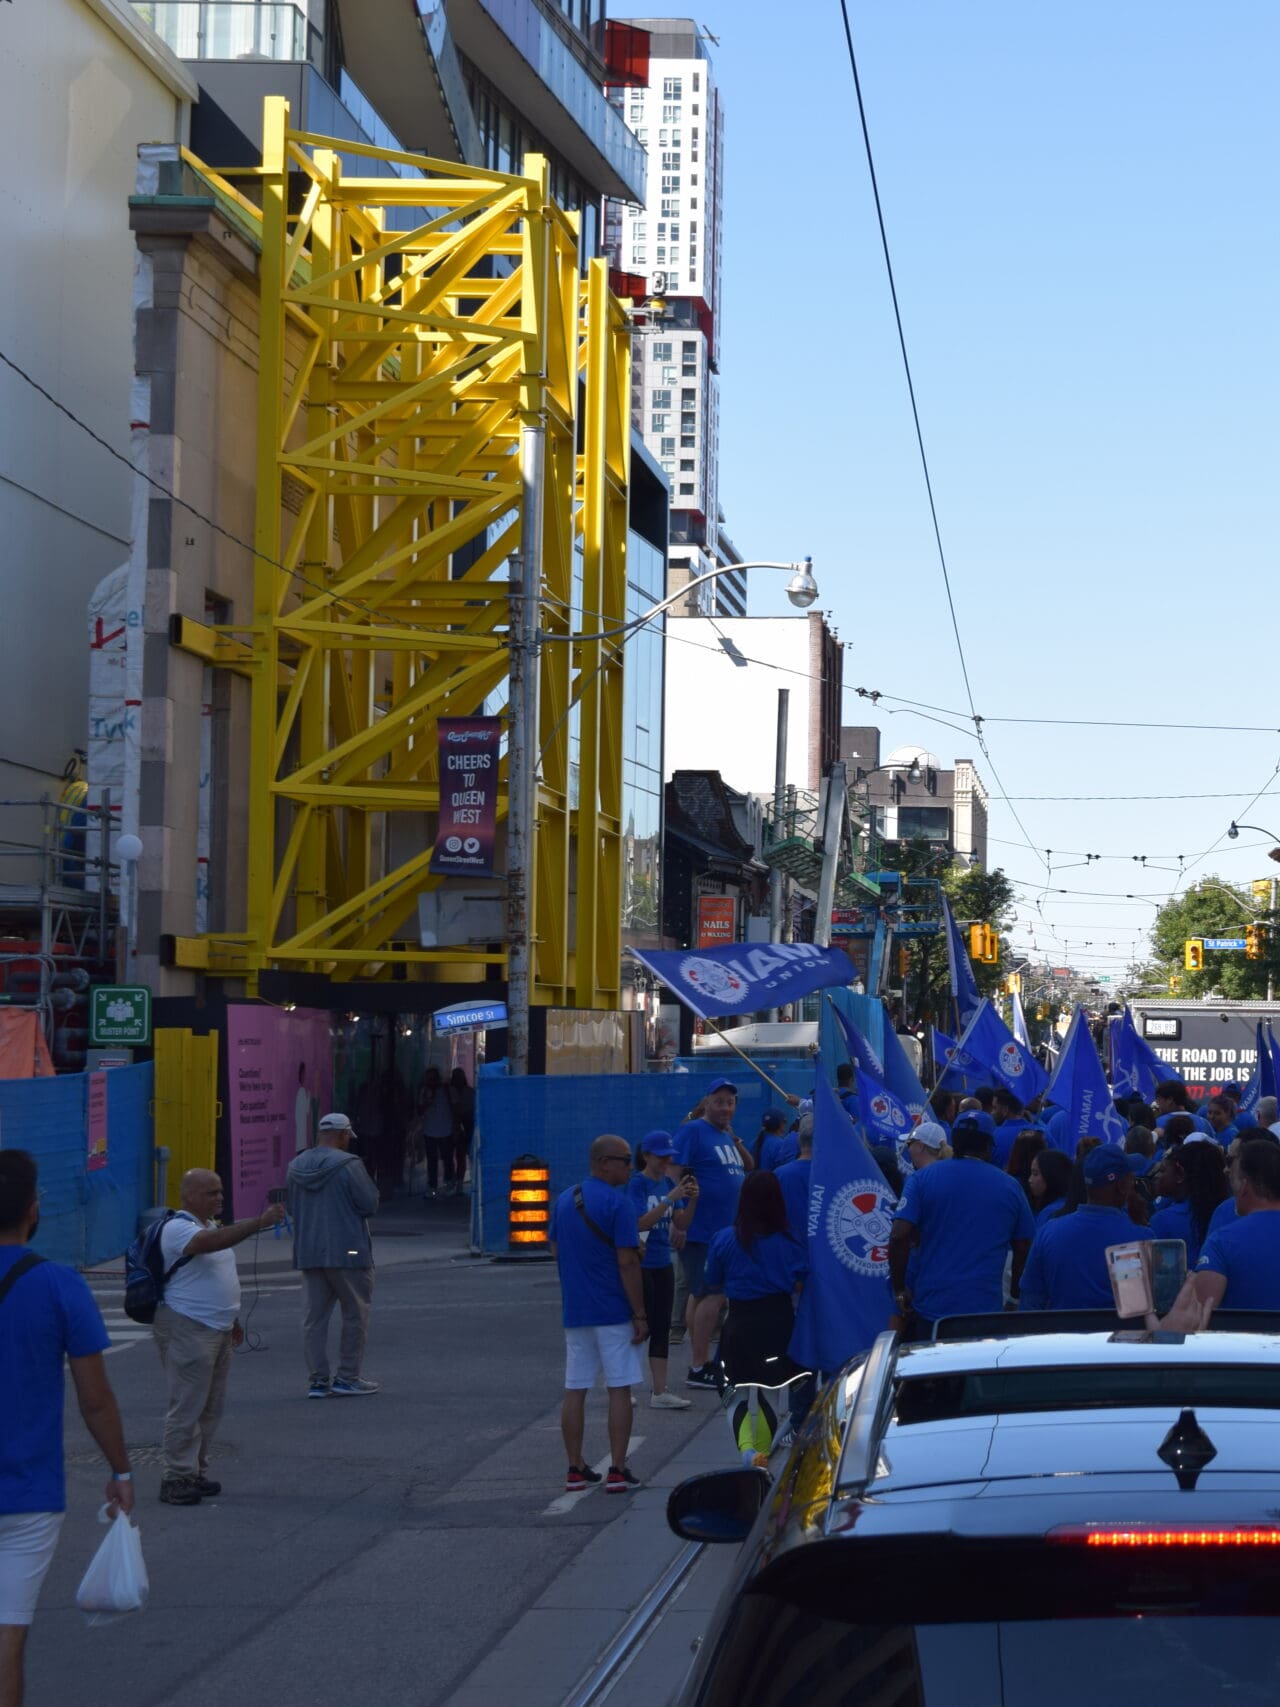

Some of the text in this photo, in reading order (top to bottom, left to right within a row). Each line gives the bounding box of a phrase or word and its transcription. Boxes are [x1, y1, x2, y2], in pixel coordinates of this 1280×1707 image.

[447, 754, 491, 770] CHEERS
[463, 773, 475, 787] TO
[452, 791, 485, 807] QUEEN
[453, 809, 481, 824] WEST
[703, 920, 730, 929] NAILS
[727, 943, 822, 982] IAM
[446, 1010, 495, 1025] Simcoe St
[1181, 1049, 1218, 1063] ROAD
[1220, 1049, 1236, 1063] TO
[1183, 1067, 1206, 1081] THE
[1209, 1067, 1233, 1081] JOB
[1237, 1067, 1250, 1081] IS
